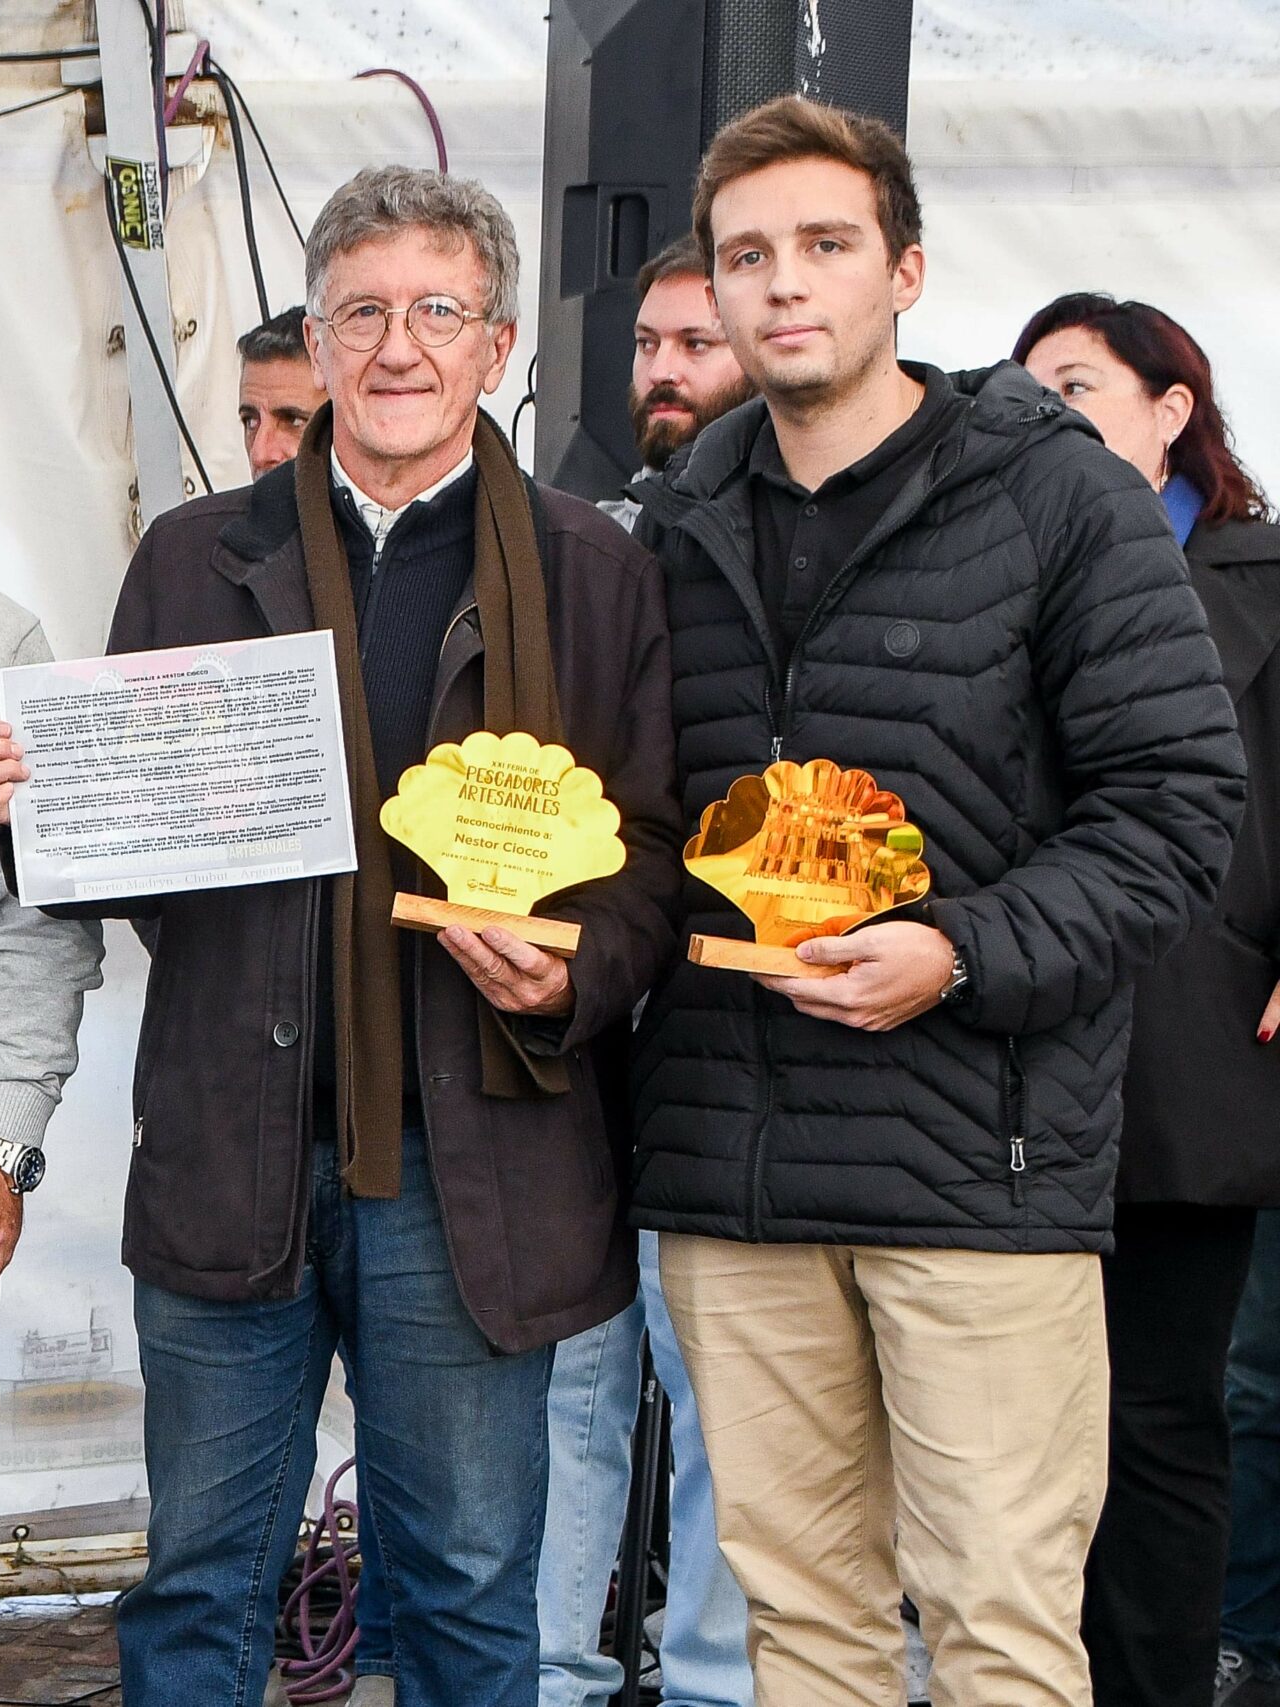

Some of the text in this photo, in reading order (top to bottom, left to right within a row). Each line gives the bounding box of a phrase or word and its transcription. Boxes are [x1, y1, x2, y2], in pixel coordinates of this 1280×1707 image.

[466, 765, 560, 797] PESCADORES
[458, 783, 560, 816] ARTESANALES
[456, 815, 540, 838] Reconocimiento
[227, 838, 302, 859] ARTESANALES
[454, 833, 548, 859] Nestor Ciocco
[184, 868, 229, 886] Chubut
